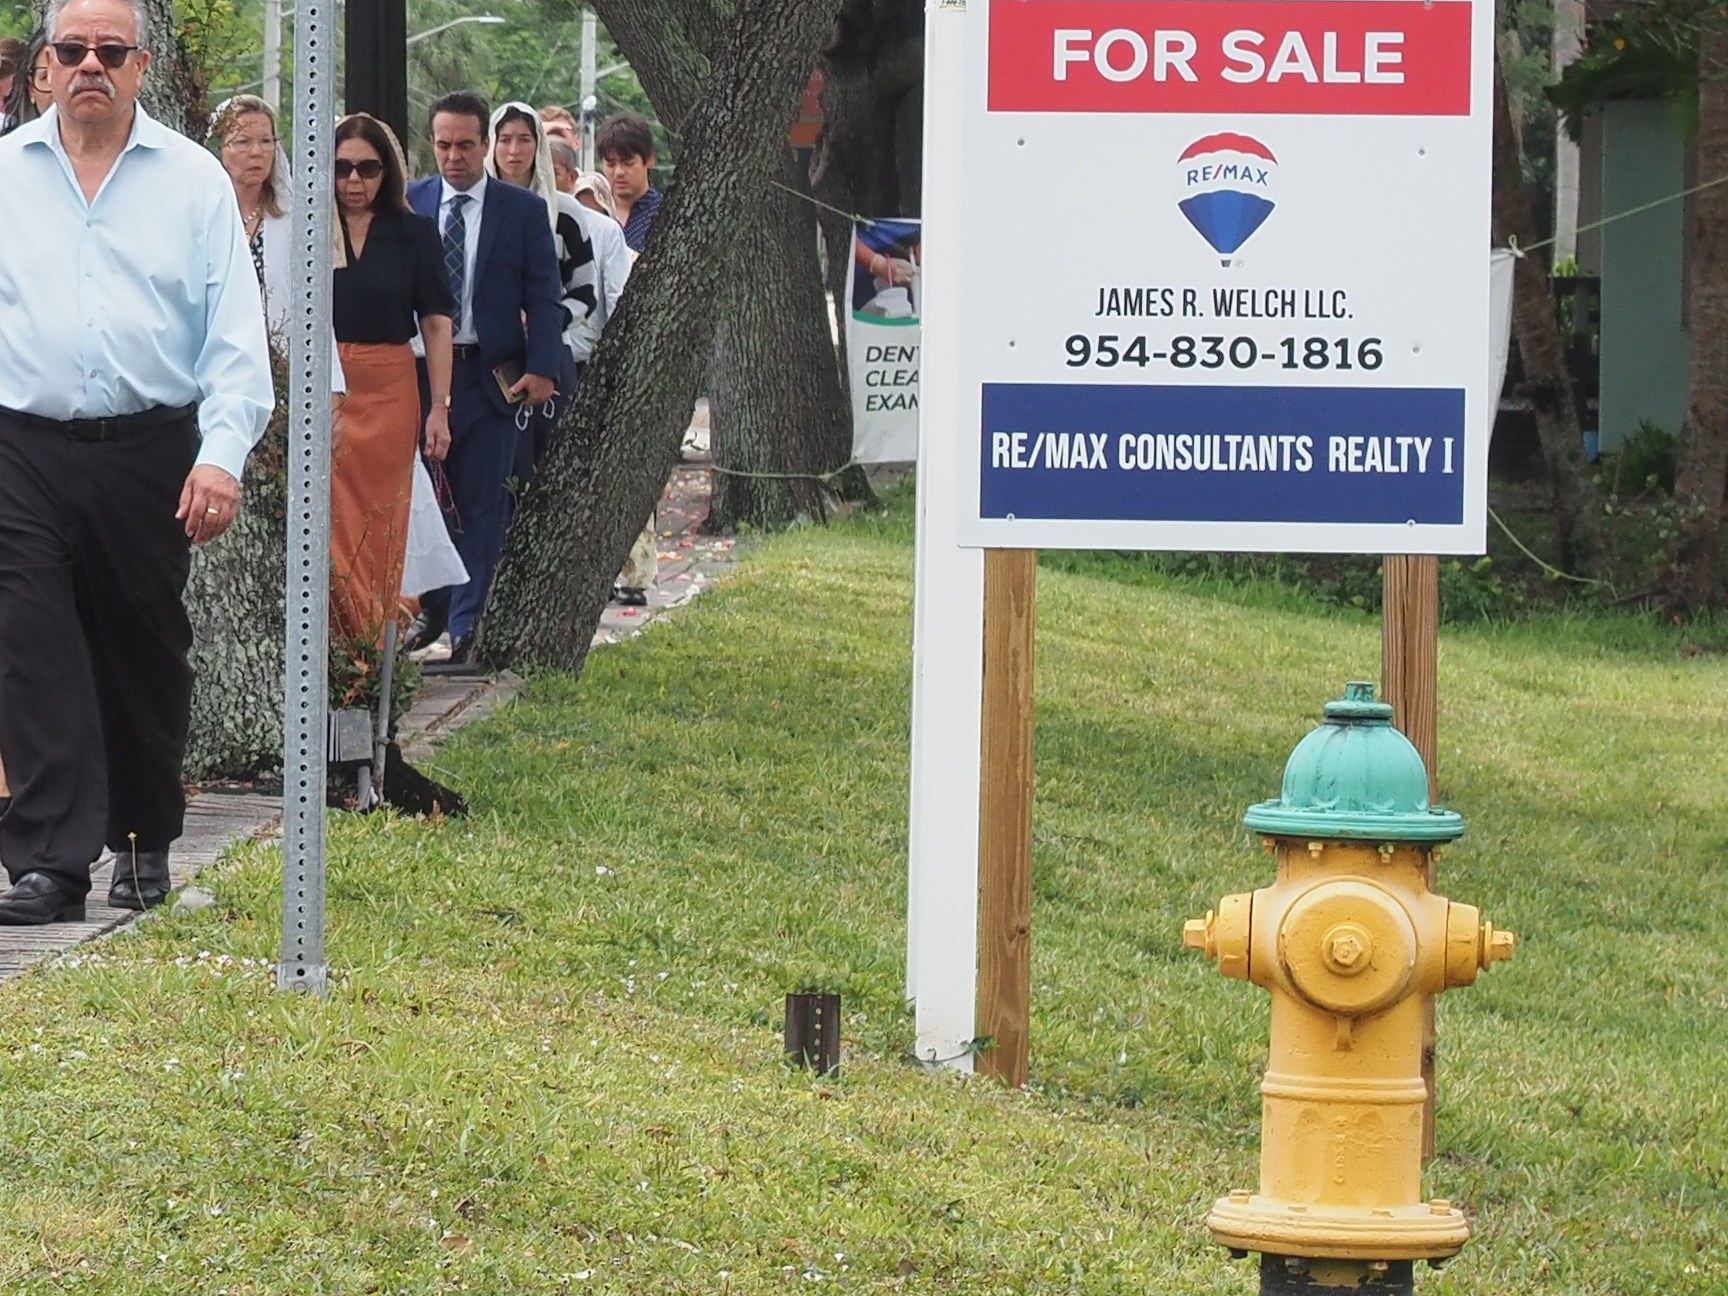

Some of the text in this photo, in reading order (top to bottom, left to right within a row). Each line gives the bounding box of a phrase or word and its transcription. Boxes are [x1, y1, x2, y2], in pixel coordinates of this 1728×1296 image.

[1053, 28, 1405, 84] FOR SALE
[1187, 163, 1268, 187] RE/MAX
[1095, 287, 1354, 319] JAMES R. WELCH LLC.
[866, 346, 919, 362] DEN
[1065, 334, 1383, 371] 954-830-1816
[992, 431, 1107, 470] RE/MAX
[1118, 433, 1313, 472] CONSULTANTS
[1328, 435, 1433, 474] REALTY
